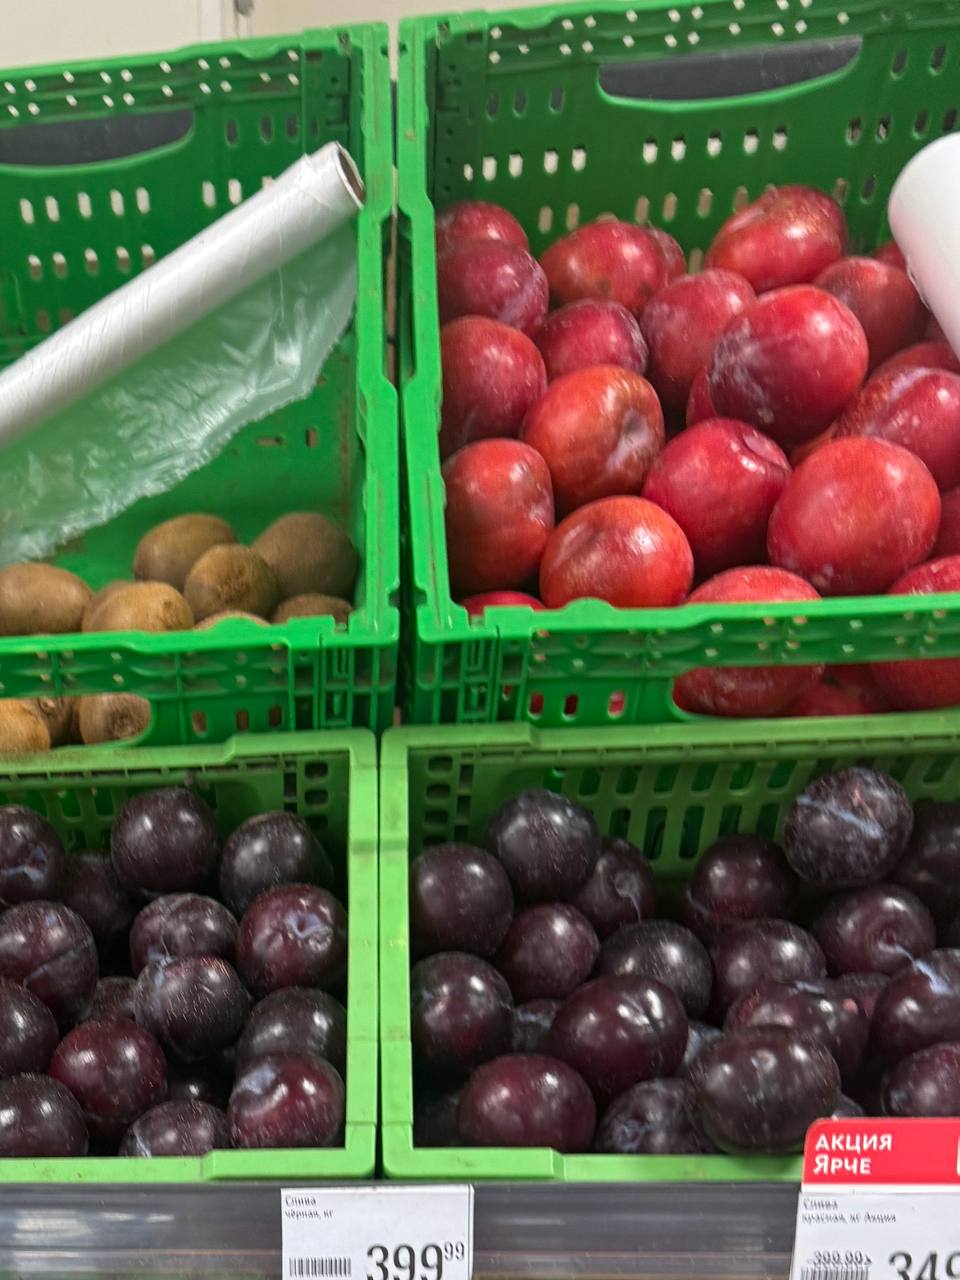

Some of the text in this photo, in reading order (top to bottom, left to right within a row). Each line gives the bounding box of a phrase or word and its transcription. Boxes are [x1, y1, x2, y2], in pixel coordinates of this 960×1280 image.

[815, 1133, 893, 1153] АКЦИЯ
[813, 1154, 872, 1175] ЯРЧЕ
[284, 1194, 317, 1207] Слива
